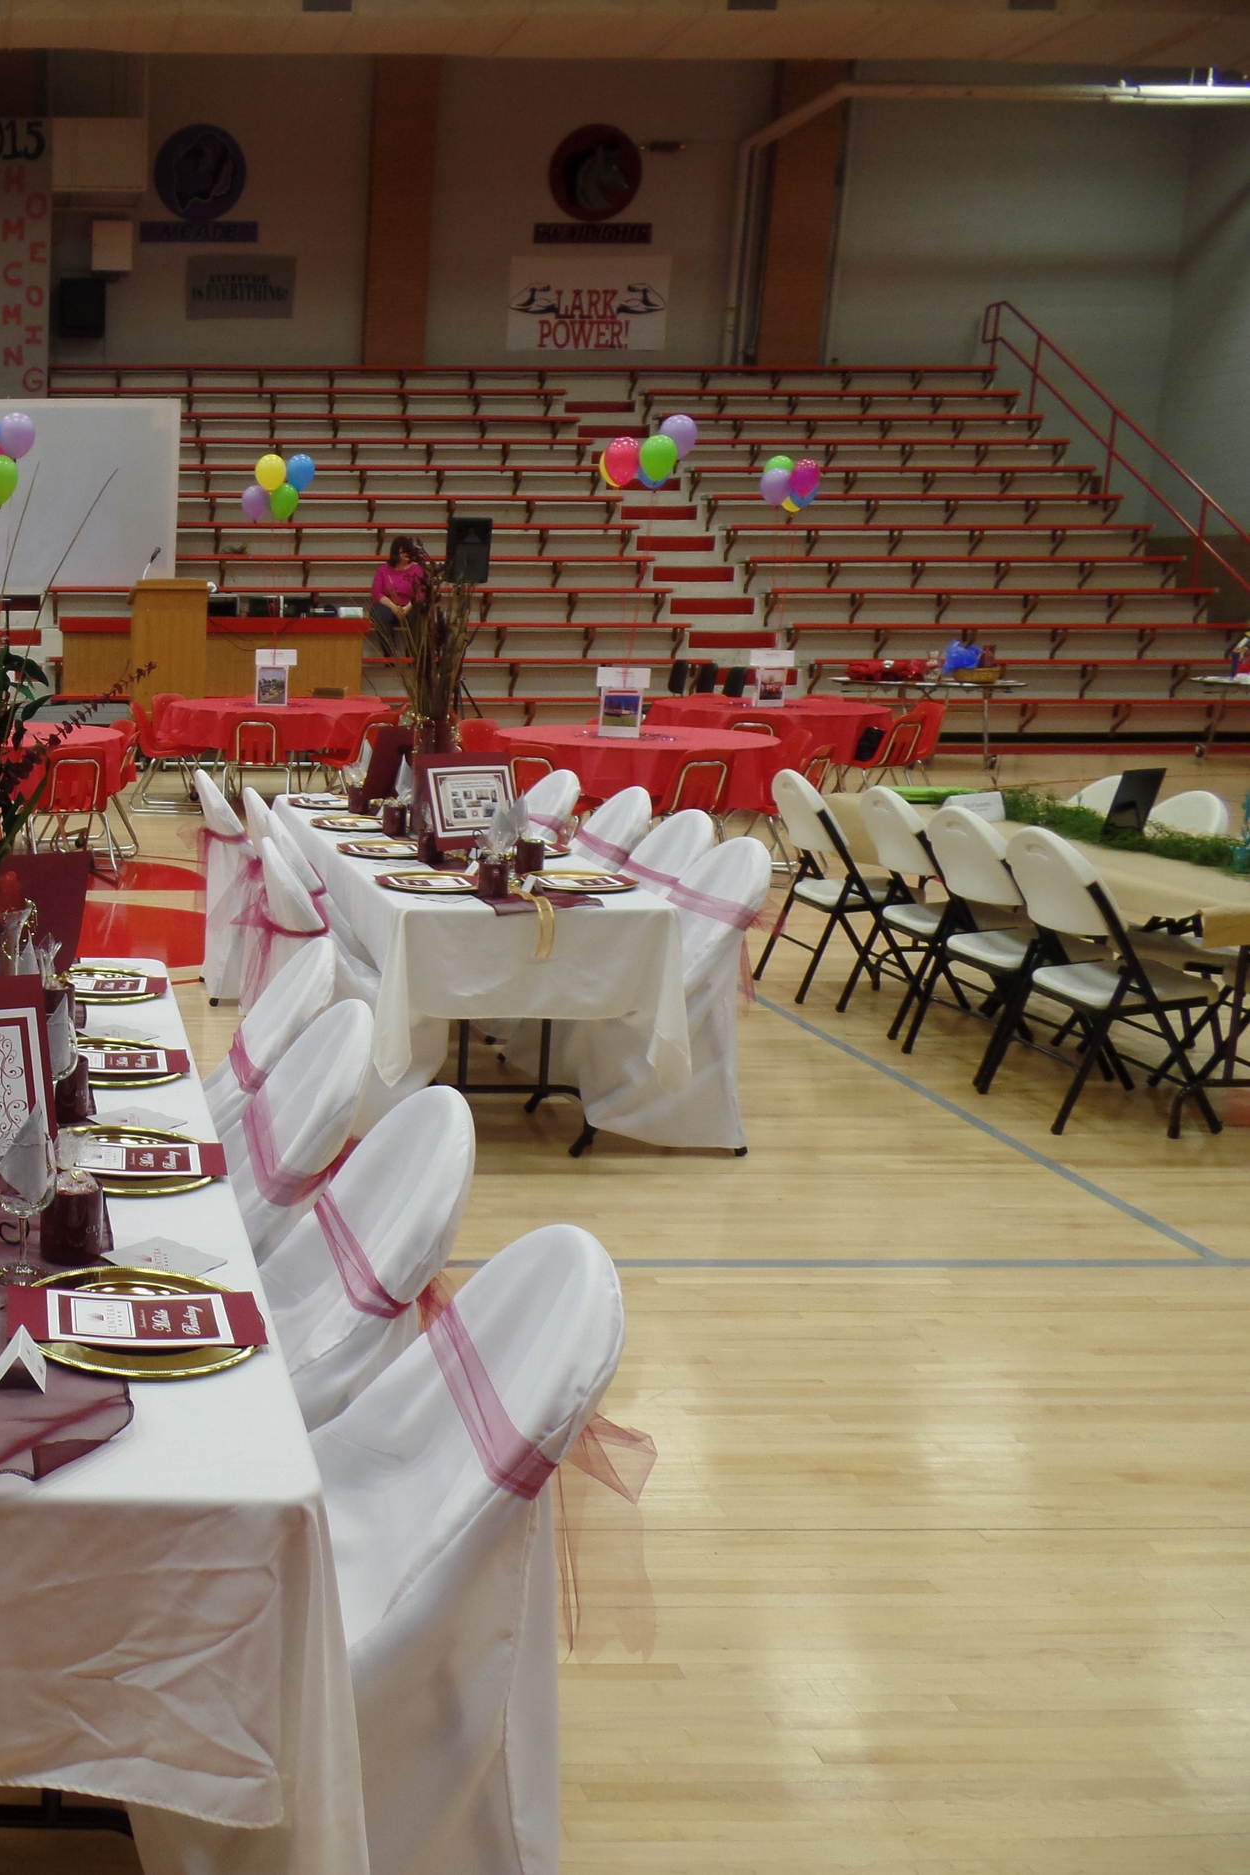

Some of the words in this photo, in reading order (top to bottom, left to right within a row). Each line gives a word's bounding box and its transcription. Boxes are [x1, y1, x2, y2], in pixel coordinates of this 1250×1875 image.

[2, 164, 47, 393] HOMECOMING
[554, 289, 619, 319] LARK
[537, 320, 630, 349] POWER!
[106, 1304, 117, 1332] CENTERA
[152, 1308, 172, 1332] Mobile
[181, 1305, 204, 1335] Banking
